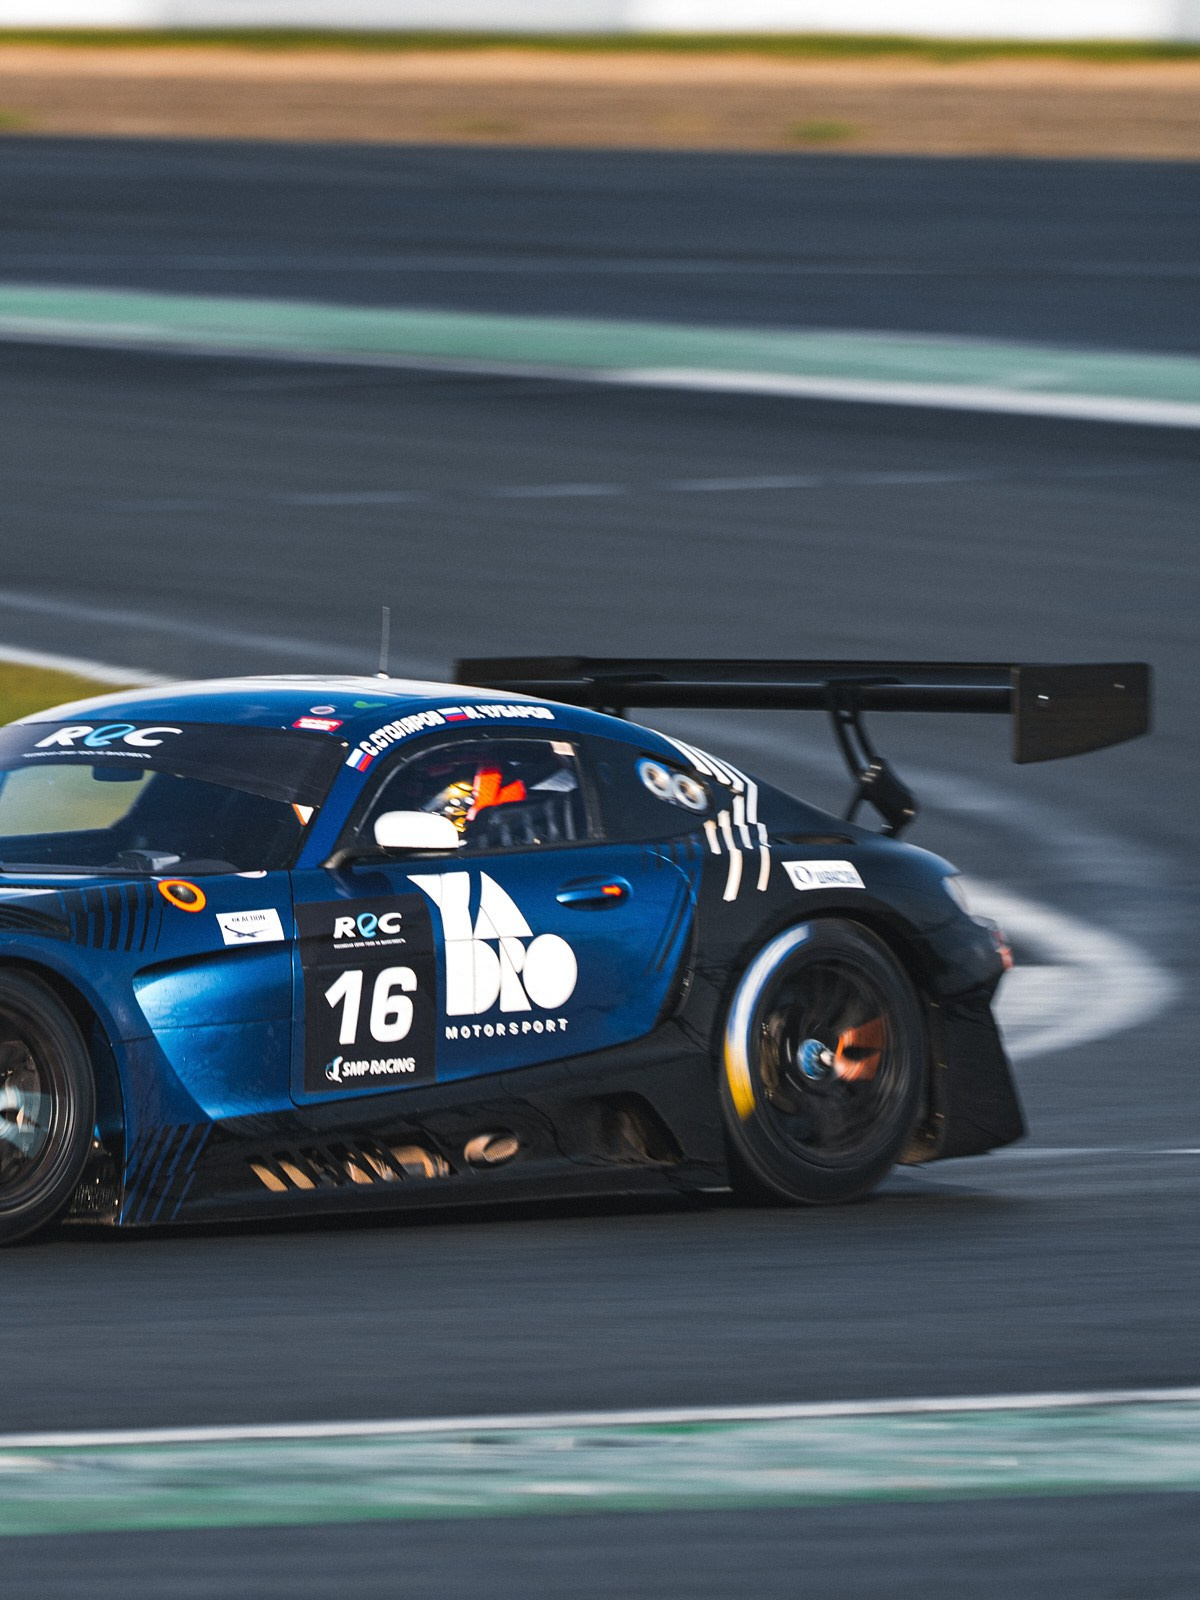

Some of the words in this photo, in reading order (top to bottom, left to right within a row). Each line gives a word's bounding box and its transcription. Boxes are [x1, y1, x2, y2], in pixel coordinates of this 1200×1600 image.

[324, 966, 417, 1045] 16
[445, 1018, 569, 1040] MOTORSPORT
[342, 1060, 370, 1077] SMP
[369, 1057, 416, 1075] RACING
